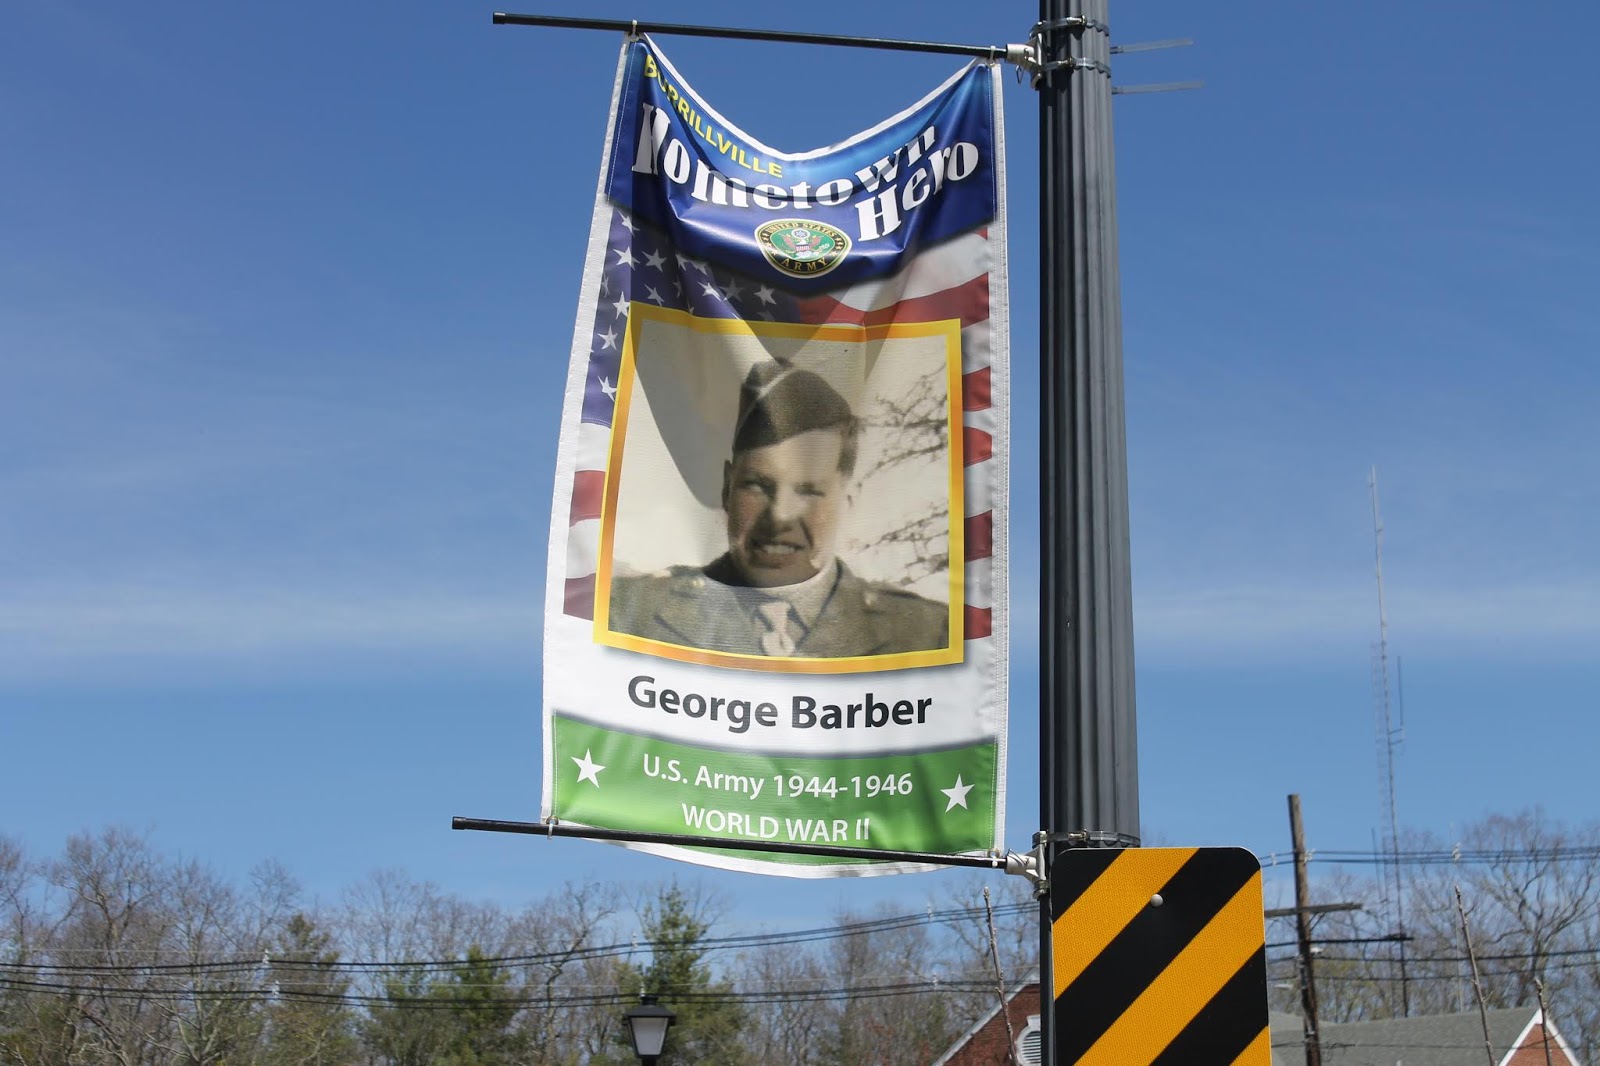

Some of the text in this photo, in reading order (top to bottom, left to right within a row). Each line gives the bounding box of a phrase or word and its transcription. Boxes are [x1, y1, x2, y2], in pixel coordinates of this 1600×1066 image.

[643, 54, 783, 179] BURRILLVILLE
[631, 102, 937, 210] Hometown
[854, 141, 980, 243] Hero
[767, 222, 837, 237] UNITED STATES
[781, 257, 828, 272] ARMY
[627, 675, 933, 734] George Barber
[643, 753, 913, 801] U.S. Army 1944-1946
[681, 802, 870, 842] WORLD WAR II
